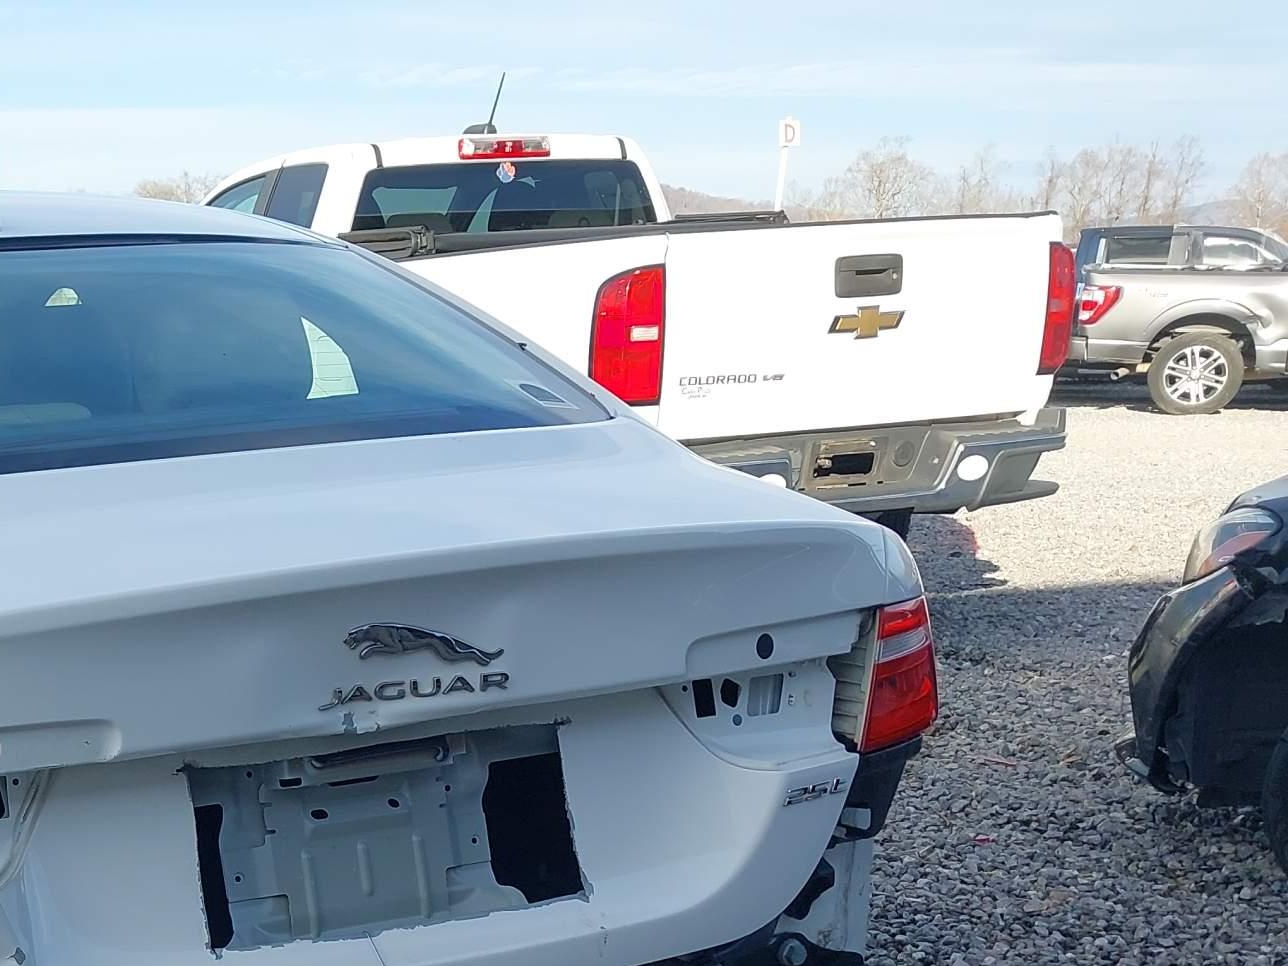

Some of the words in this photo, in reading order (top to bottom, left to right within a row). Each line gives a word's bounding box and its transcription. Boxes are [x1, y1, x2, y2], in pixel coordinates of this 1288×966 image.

[784, 123, 796, 143] D
[679, 373, 757, 386] COLORADO
[318, 671, 510, 711] JAGUAR
